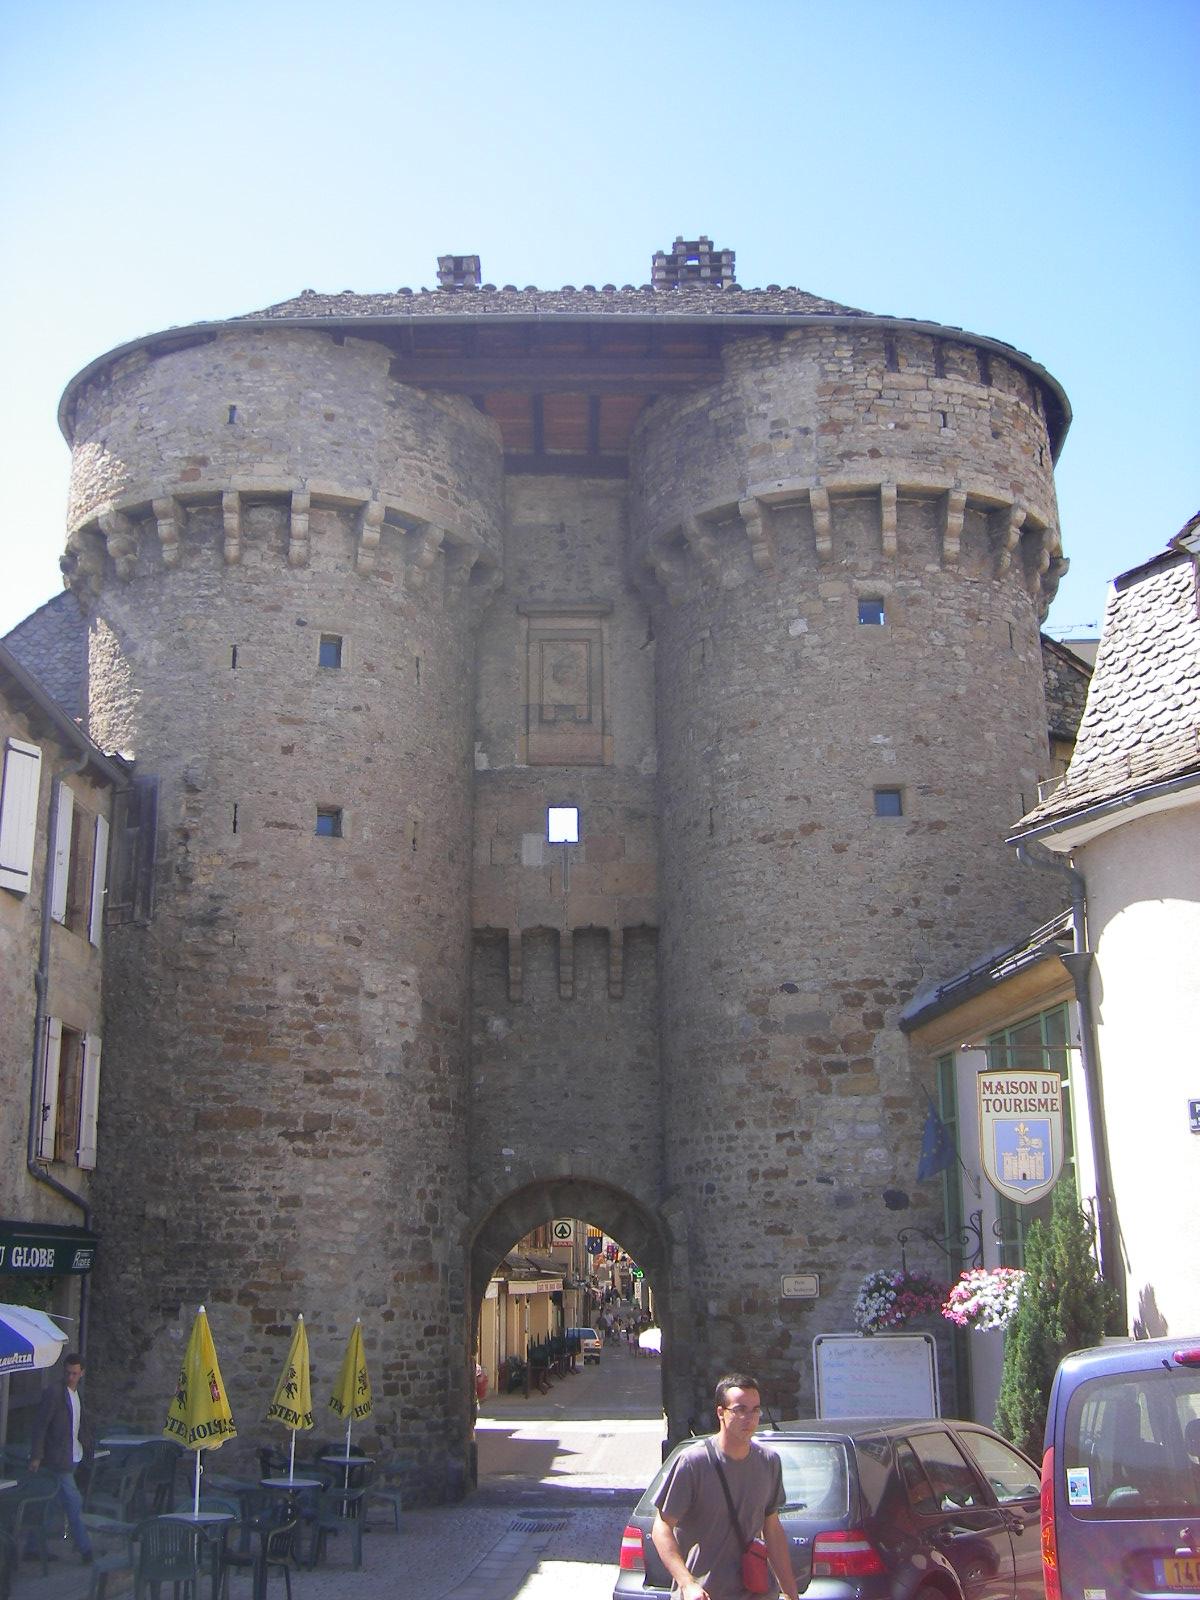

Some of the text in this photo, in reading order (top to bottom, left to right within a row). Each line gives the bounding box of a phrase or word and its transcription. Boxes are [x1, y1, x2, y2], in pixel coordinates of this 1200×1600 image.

[982, 1080, 1058, 1095] MAISON DU
[982, 1097, 1059, 1113] TOURISME
[11, 1246, 55, 1268] GLOBE
